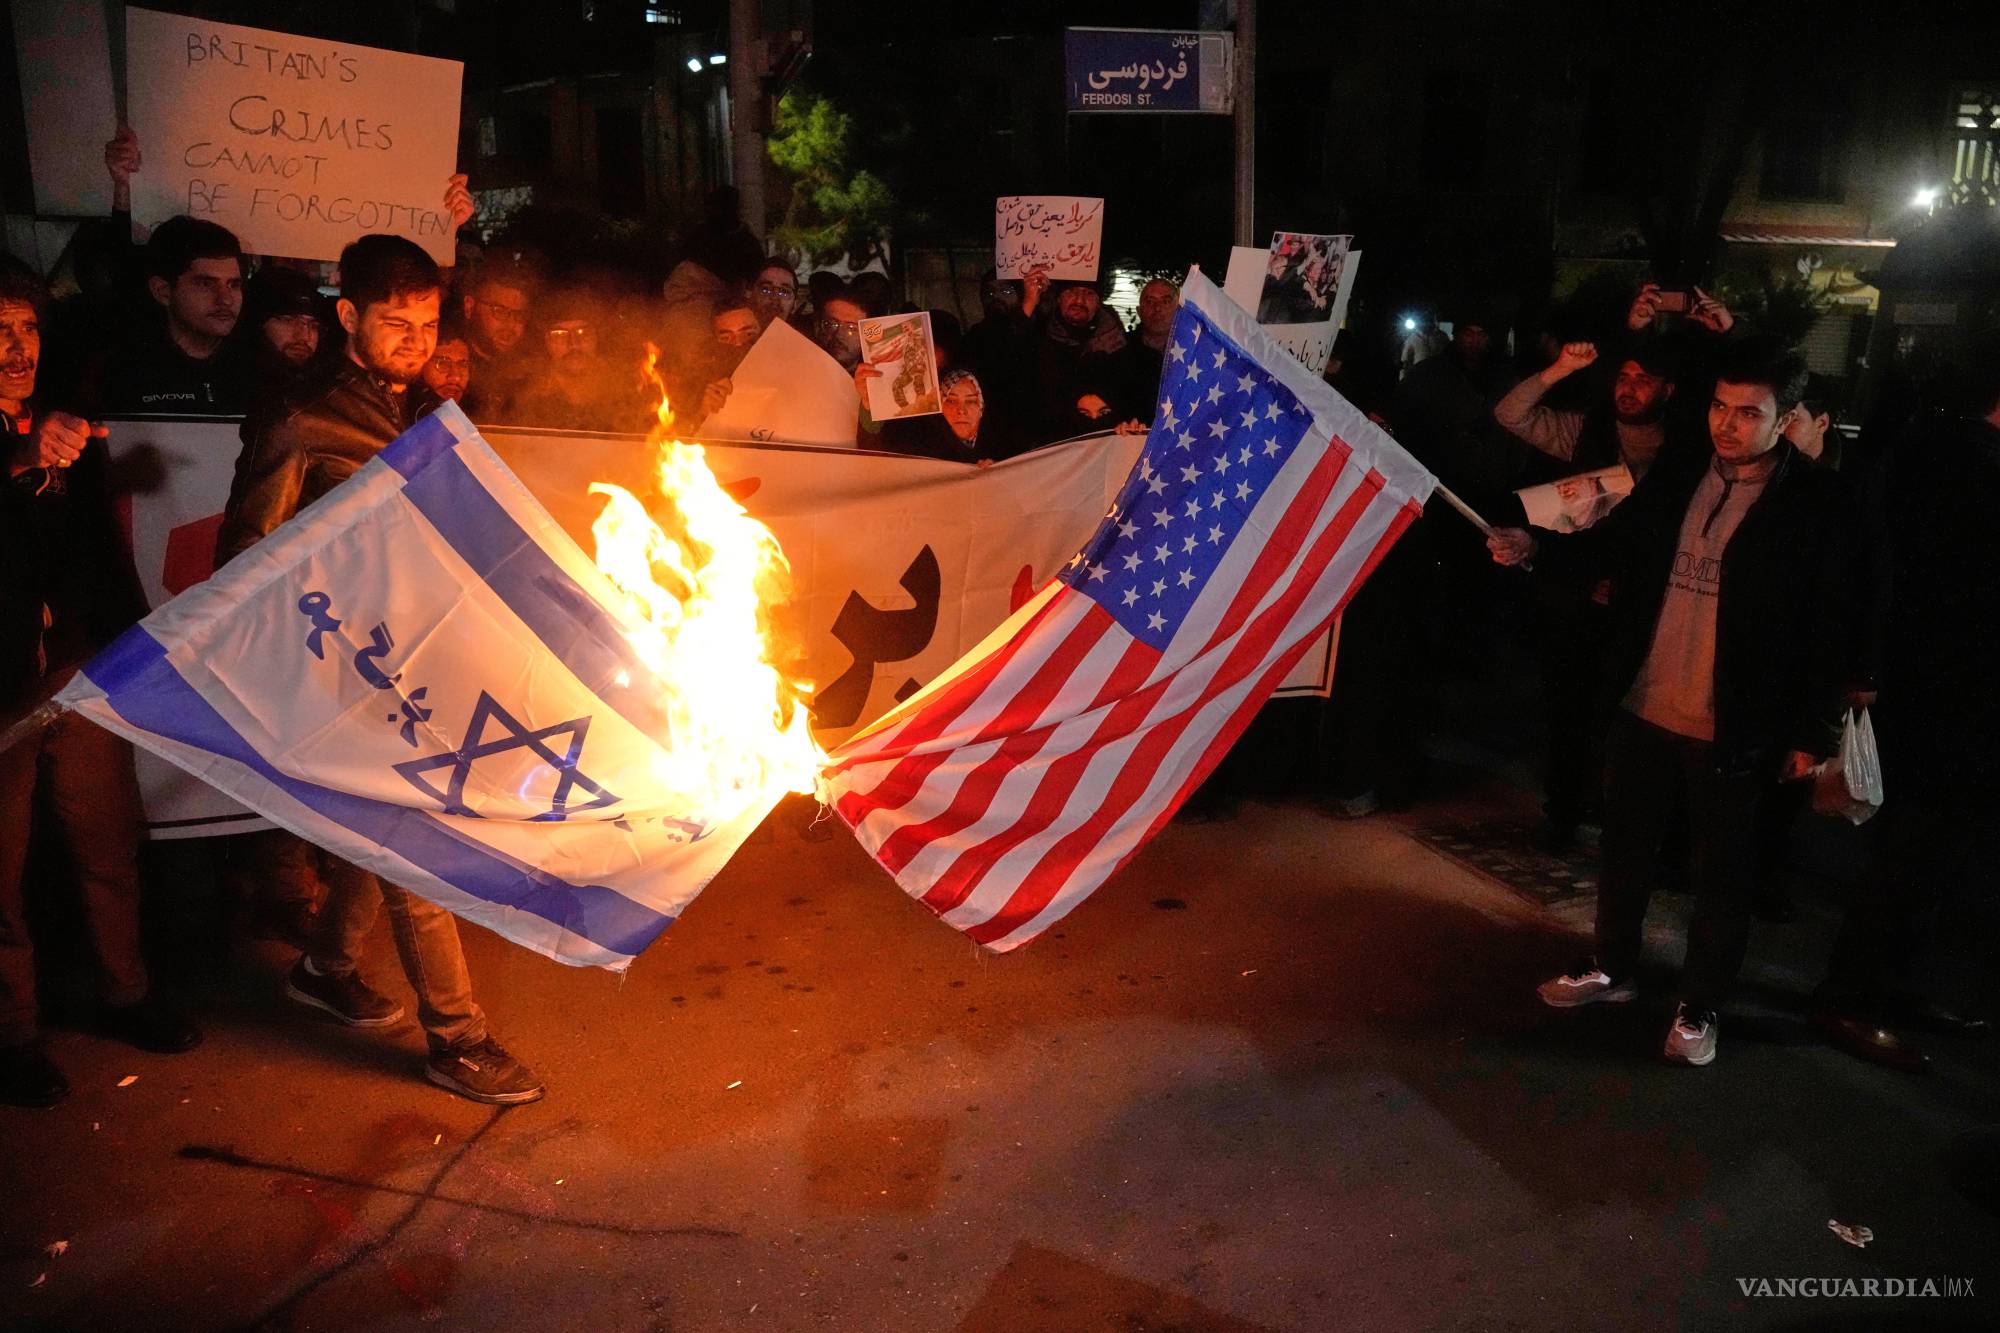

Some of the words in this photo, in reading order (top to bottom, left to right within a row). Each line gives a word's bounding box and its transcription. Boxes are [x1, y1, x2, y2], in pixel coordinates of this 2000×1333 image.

[1171, 35, 1199, 48] خیابان
[187, 33, 357, 83] BRITAIN'S
[1088, 51, 1188, 91] فردوسی
[1082, 93, 1132, 105] FERDOSI
[1137, 93, 1154, 105] ST.
[229, 95, 393, 150] CRIMES
[184, 142, 328, 184] CANNOT
[187, 179, 230, 215] BE
[250, 188, 453, 235] FORGOTTEN
[1017, 203, 1044, 221] حق
[1029, 210, 1065, 230] یعنی
[1065, 199, 1102, 234] کربلا
[1056, 243, 1085, 263] حق
[1072, 241, 1095, 268] یار
[142, 393, 196, 403] GIVOVA
